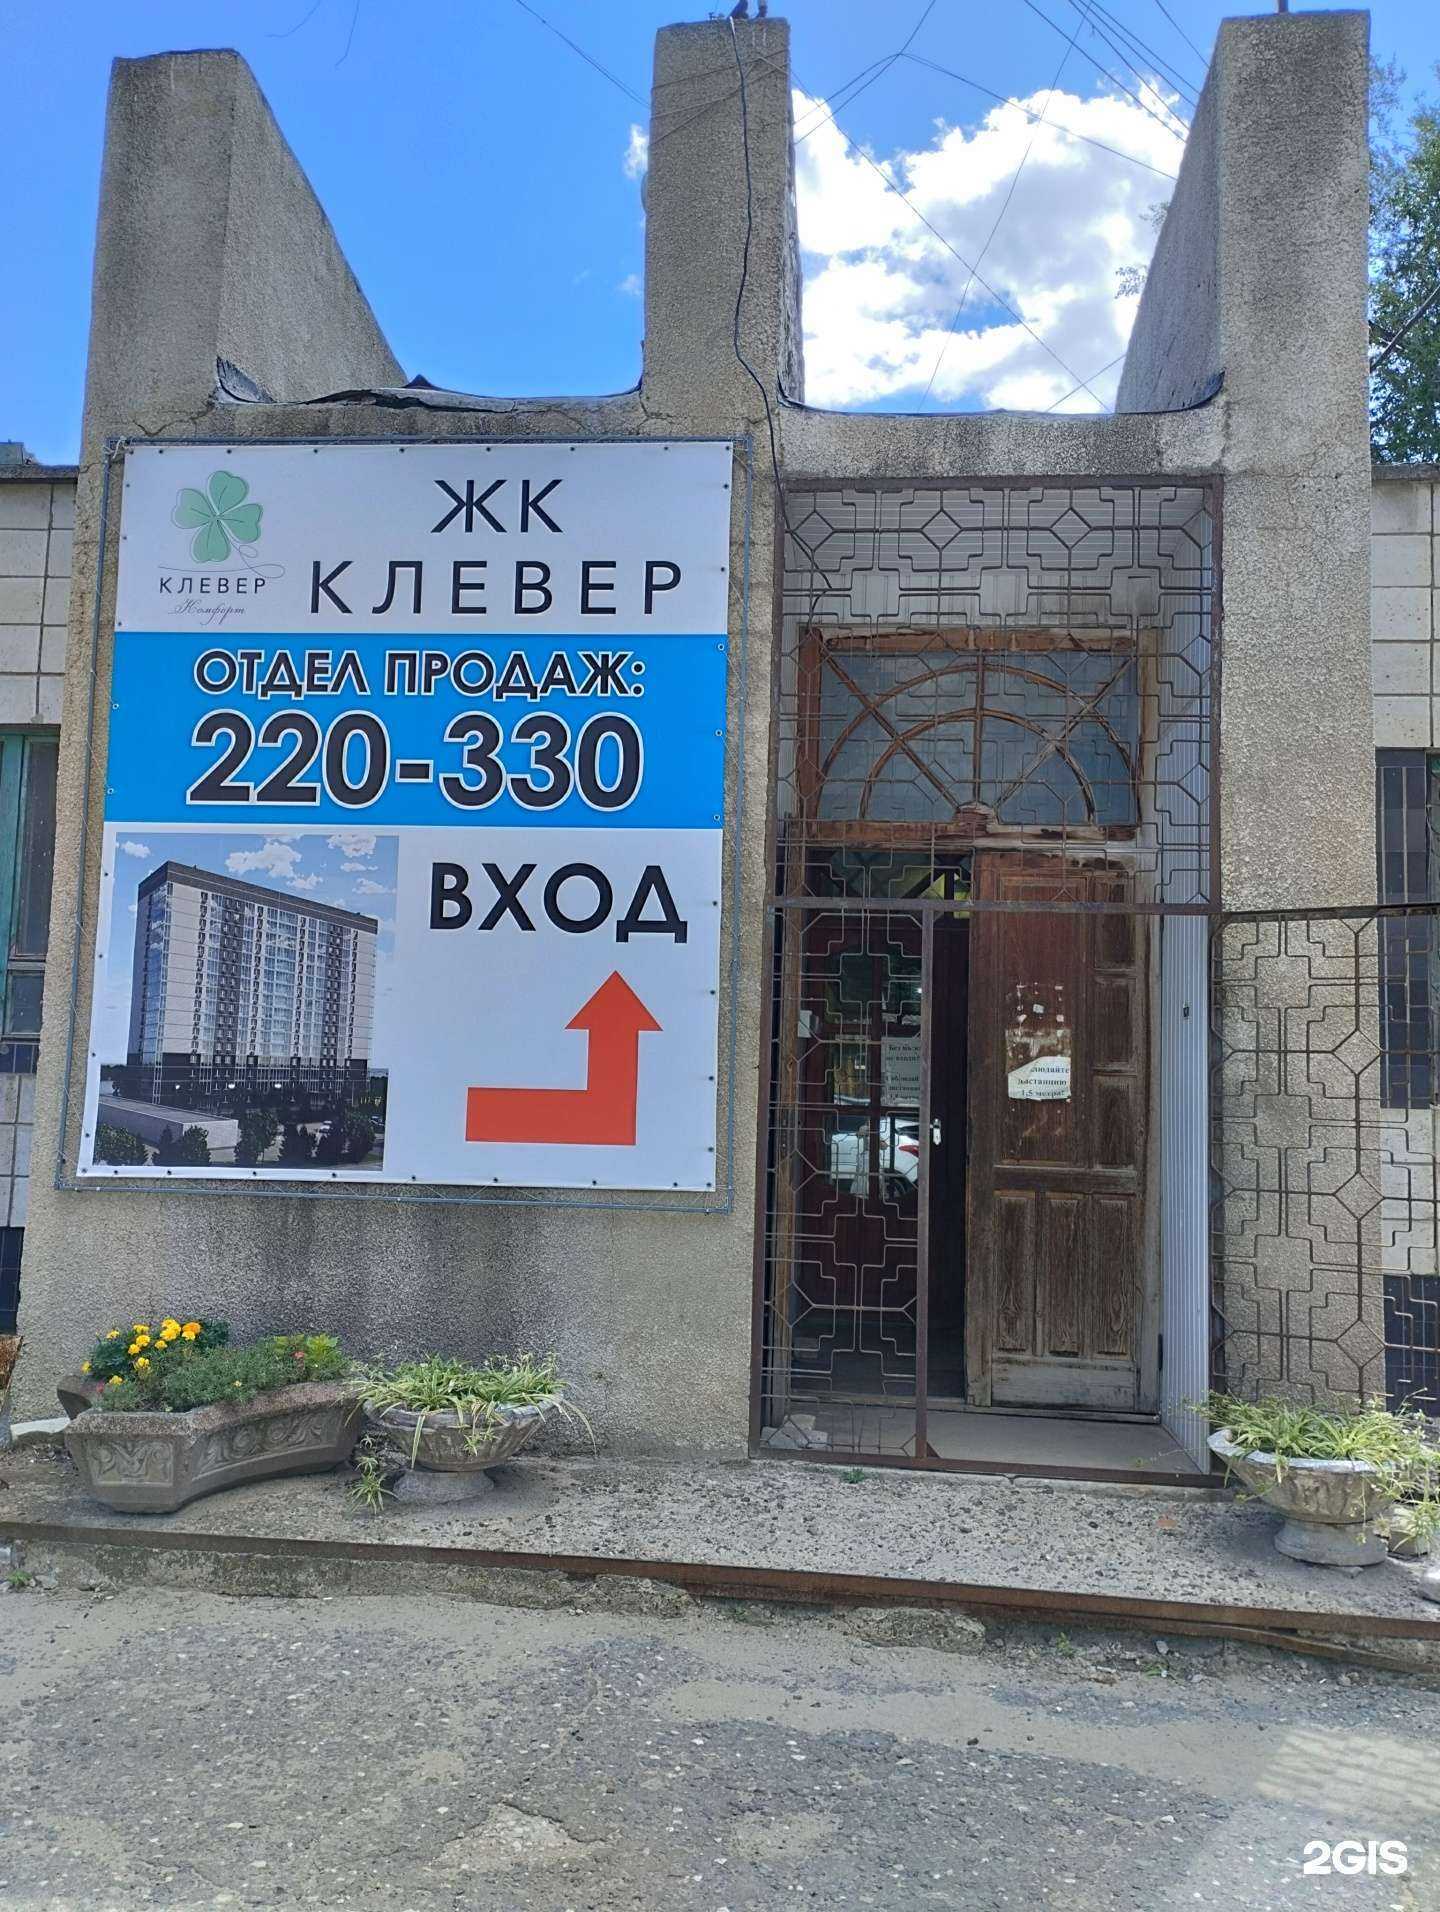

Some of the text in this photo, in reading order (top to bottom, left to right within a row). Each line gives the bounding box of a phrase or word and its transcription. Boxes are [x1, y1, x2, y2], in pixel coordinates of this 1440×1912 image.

[431, 479, 565, 534] ЖК
[159, 576, 267, 595] КЛЕВЕР
[167, 598, 246, 626] Комфорт
[311, 560, 683, 615] КЛЕВЕР
[194, 648, 646, 702] ОТДЕЛ ПРОДАЖ:
[186, 708, 645, 812] 220-330
[429, 861, 688, 944] ВХОД
